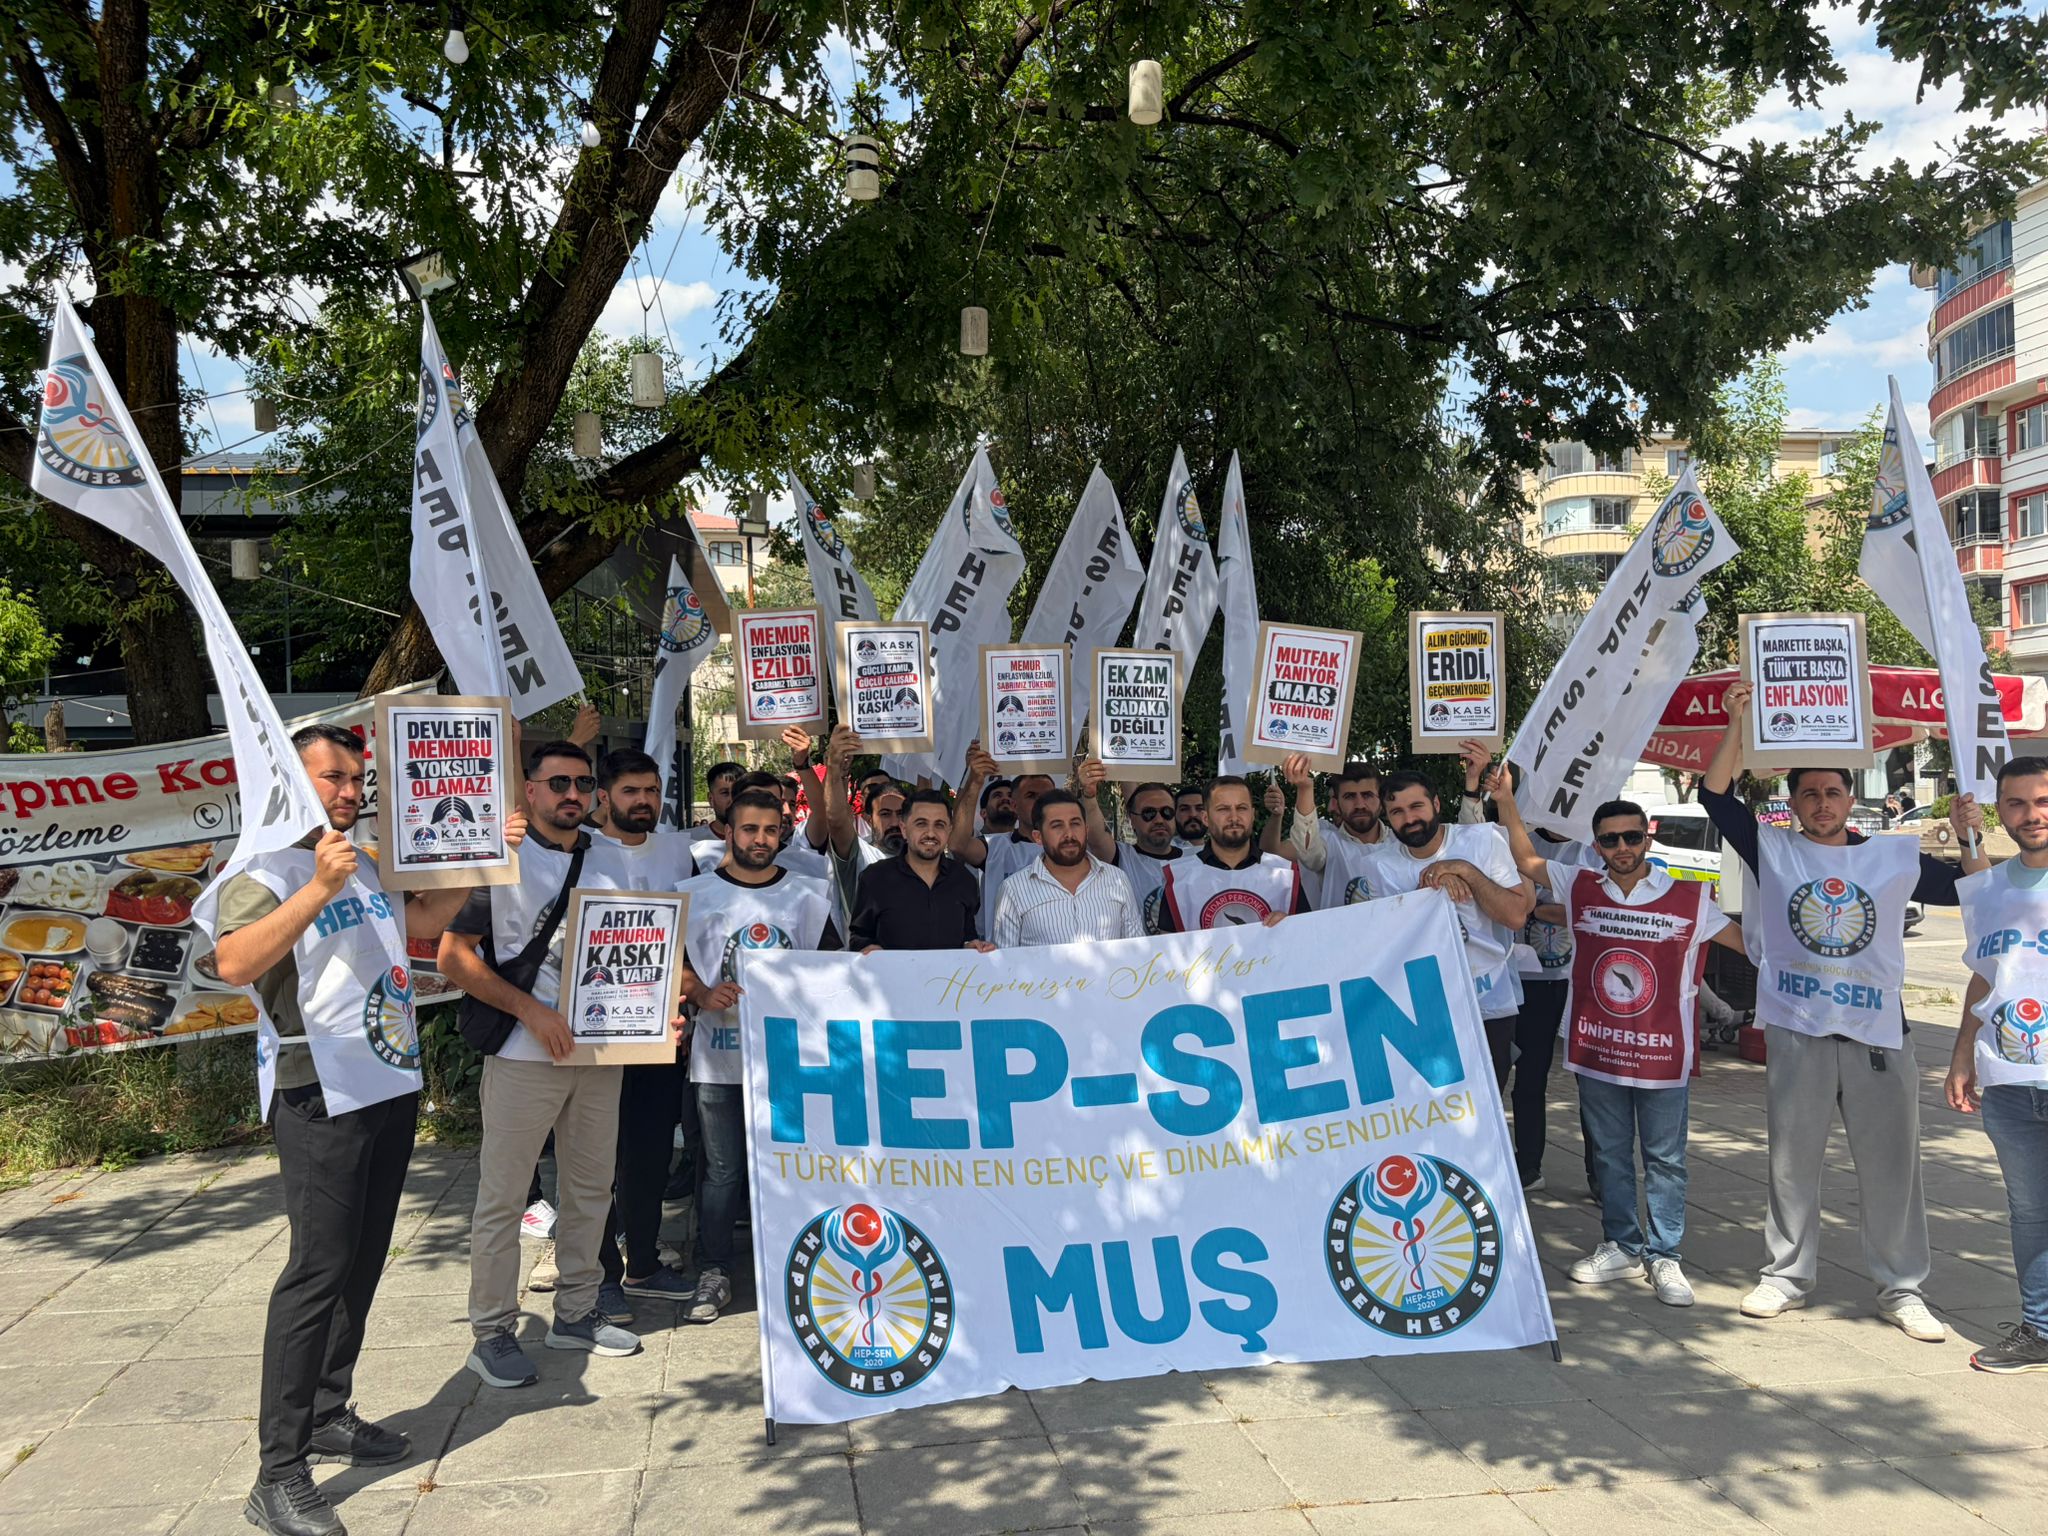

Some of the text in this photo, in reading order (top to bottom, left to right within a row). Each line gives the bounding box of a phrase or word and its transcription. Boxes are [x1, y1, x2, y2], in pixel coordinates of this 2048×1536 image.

[750, 625, 810, 646] MEMUR
[1427, 631, 1488, 648] ALIM GÜCÜMÜZ
[751, 644, 811, 658] ENFLASYONA
[880, 641, 914, 649] KASK
[1762, 639, 1847, 655] MARKETTE BAŞKA,
[1010, 660, 1041, 671] MEMUR
[1276, 646, 1340, 669] MUTFAK
[1427, 648, 1491, 682] ERİDİ,
[862, 664, 886, 676] GÜÇLÜ
[998, 671, 1034, 681] ENFLASYONA
[1108, 664, 1168, 685] EK ZAM
[1275, 663, 1340, 688] YANIYOR,
[1810, 660, 1845, 683] BAŞKA
[859, 677, 883, 688] GÜÇLÜ
[997, 681, 1027, 690] SABRIMIZ
[779, 694, 813, 704] KASK
[858, 687, 892, 702] GÜÇLÜ
[1108, 685, 1168, 700] HAKKIMIZ,
[1274, 682, 1331, 707] MAAŞ
[1428, 683, 1490, 699] GEÇİNEMİYORUZ!
[1765, 685, 1849, 708] ENFLASYON!
[858, 700, 894, 715] KASK!
[1110, 700, 1167, 716] SADAKA
[1269, 701, 1334, 721] YETMİYOR!
[1453, 706, 1491, 715] KASK
[1110, 717, 1165, 735] DEĞİL!
[1800, 715, 1848, 724] KASK
[407, 717, 492, 740] DEVLETİN
[1019, 730, 1056, 739] KASK
[1292, 723, 1329, 735] KASK
[408, 739, 493, 759] MEMURU
[1130, 738, 1166, 747] KASK
[416, 760, 485, 778] YOKSUL
[411, 776, 492, 797] OLAMAZ!
[0, 823, 131, 855] özleme
[441, 827, 491, 839] KASK
[600, 910, 656, 929] ARTIK
[1590, 910, 1674, 929] HAKLARIMIZ İÇİN
[589, 927, 666, 946] MEMURUN
[1599, 924, 1660, 940] BURADAYIZ!
[586, 943, 666, 969] KASK'I
[1820, 946, 1850, 956] HEP
[621, 967, 657, 983] VAR!
[924, 943, 1281, 1013] Hepimizin Sendikası
[1778, 970, 1883, 1010] HEP-SEN
[611, 1006, 655, 1015] KASK
[1577, 1016, 1674, 1048] ÜNİPERSEN
[763, 953, 1466, 1150] HEP-SEN
[1634, 1051, 1673, 1062] Personel
[1598, 1055, 1641, 1069] Sendikası
[772, 1090, 1476, 1189] TÜRKİYENİN EN GENÇ VE DİNAMİK SENDİKASI
[1406, 1306, 1461, 1334] HEP
[1445, 1172, 1496, 1298] SENİNLE
[1003, 1227, 1279, 1354] MUŞ
[1405, 1288, 1445, 1305] HEP-SEN
[850, 1371, 905, 1392] HEP
[907, 1235, 949, 1367] SENİNLE
[1416, 1300, 1437, 1311] 2020
[854, 1348, 892, 1359] HEP-SEN
[863, 1358, 883, 1367] 2020
